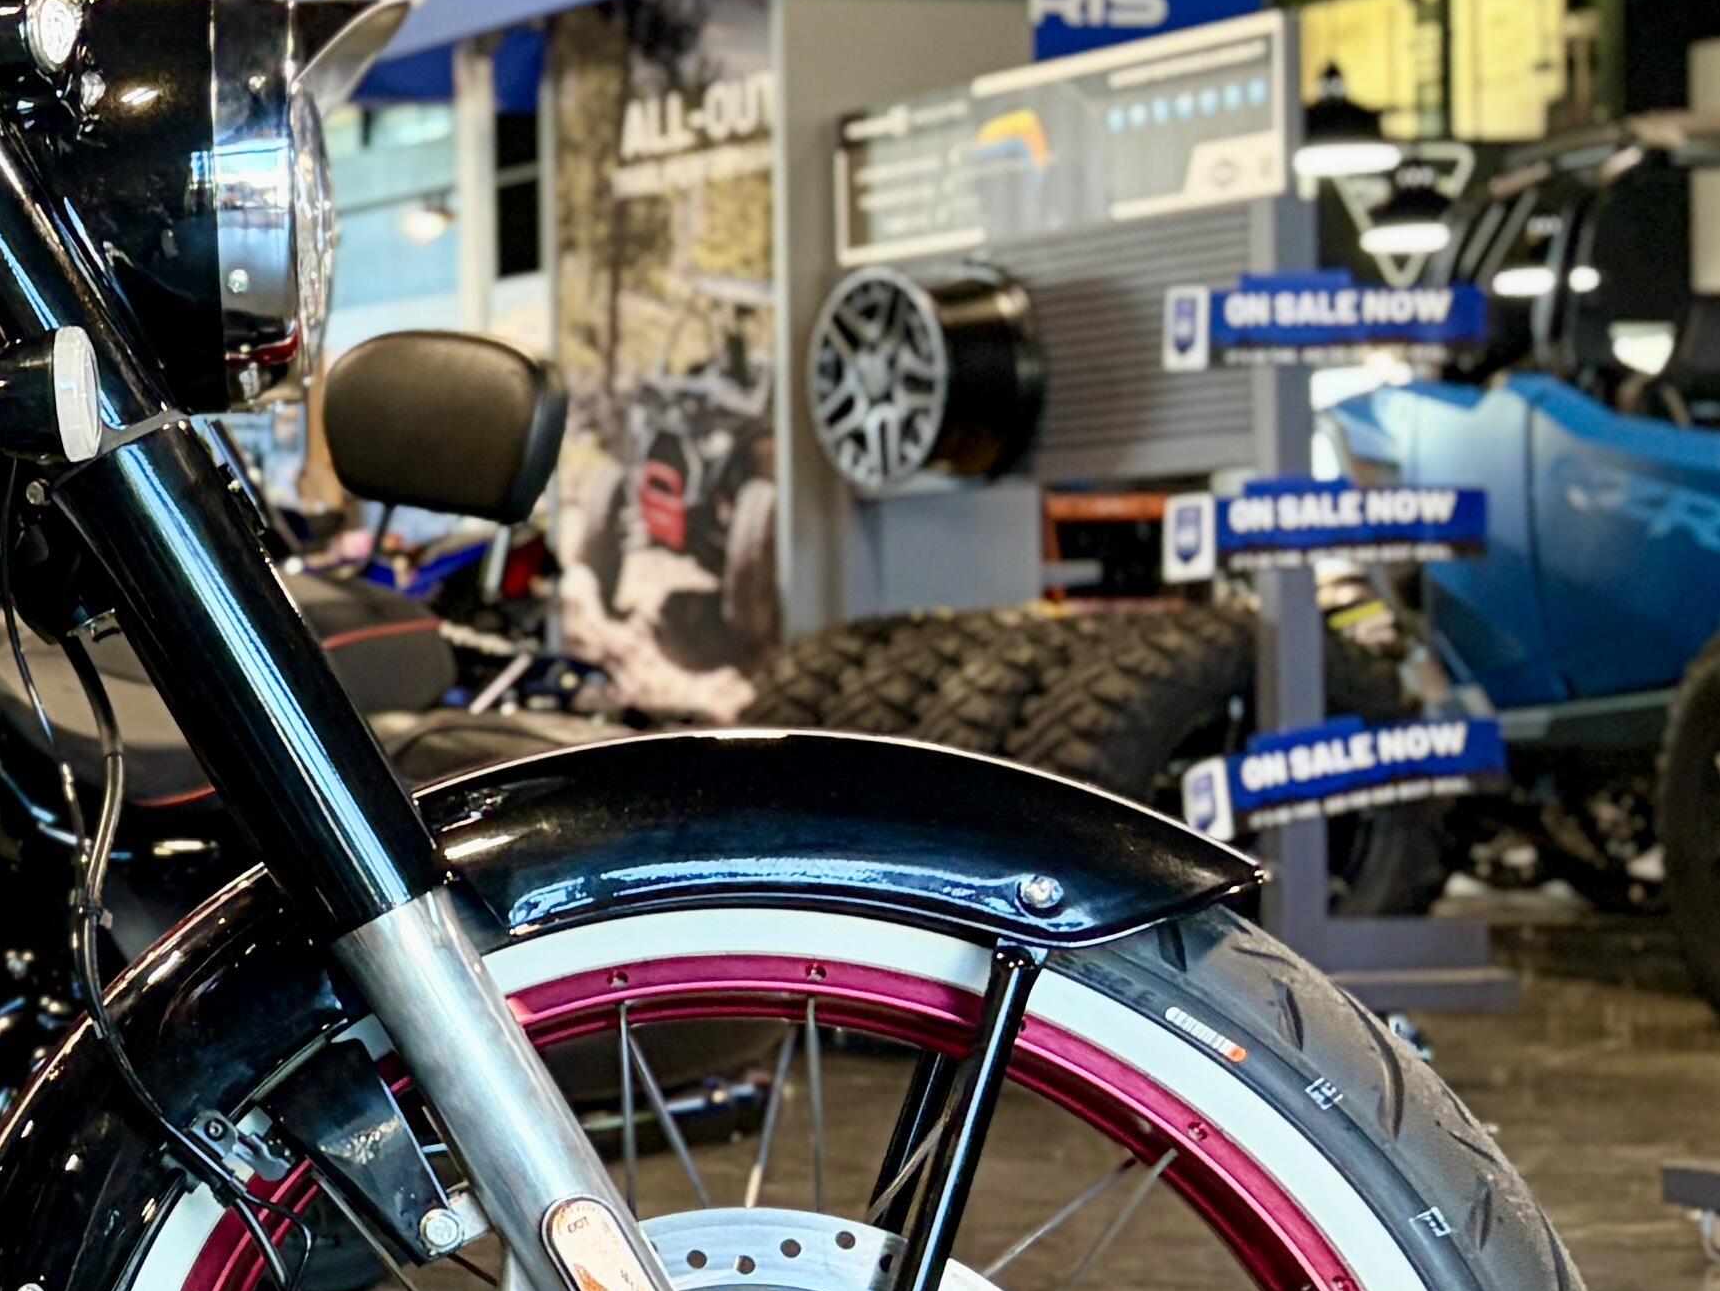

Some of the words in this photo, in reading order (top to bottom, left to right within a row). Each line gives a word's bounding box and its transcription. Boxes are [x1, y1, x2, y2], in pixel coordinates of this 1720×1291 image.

[1224, 293, 1270, 328] ON
[1275, 290, 1359, 326] SALE
[1363, 289, 1453, 323] NOW
[1228, 499, 1273, 533] ON
[1279, 493, 1362, 530] SALE
[1367, 489, 1457, 524] NOW
[1241, 752, 1289, 791] ON
[1289, 731, 1375, 781] SALE
[1376, 722, 1468, 763] NOW
